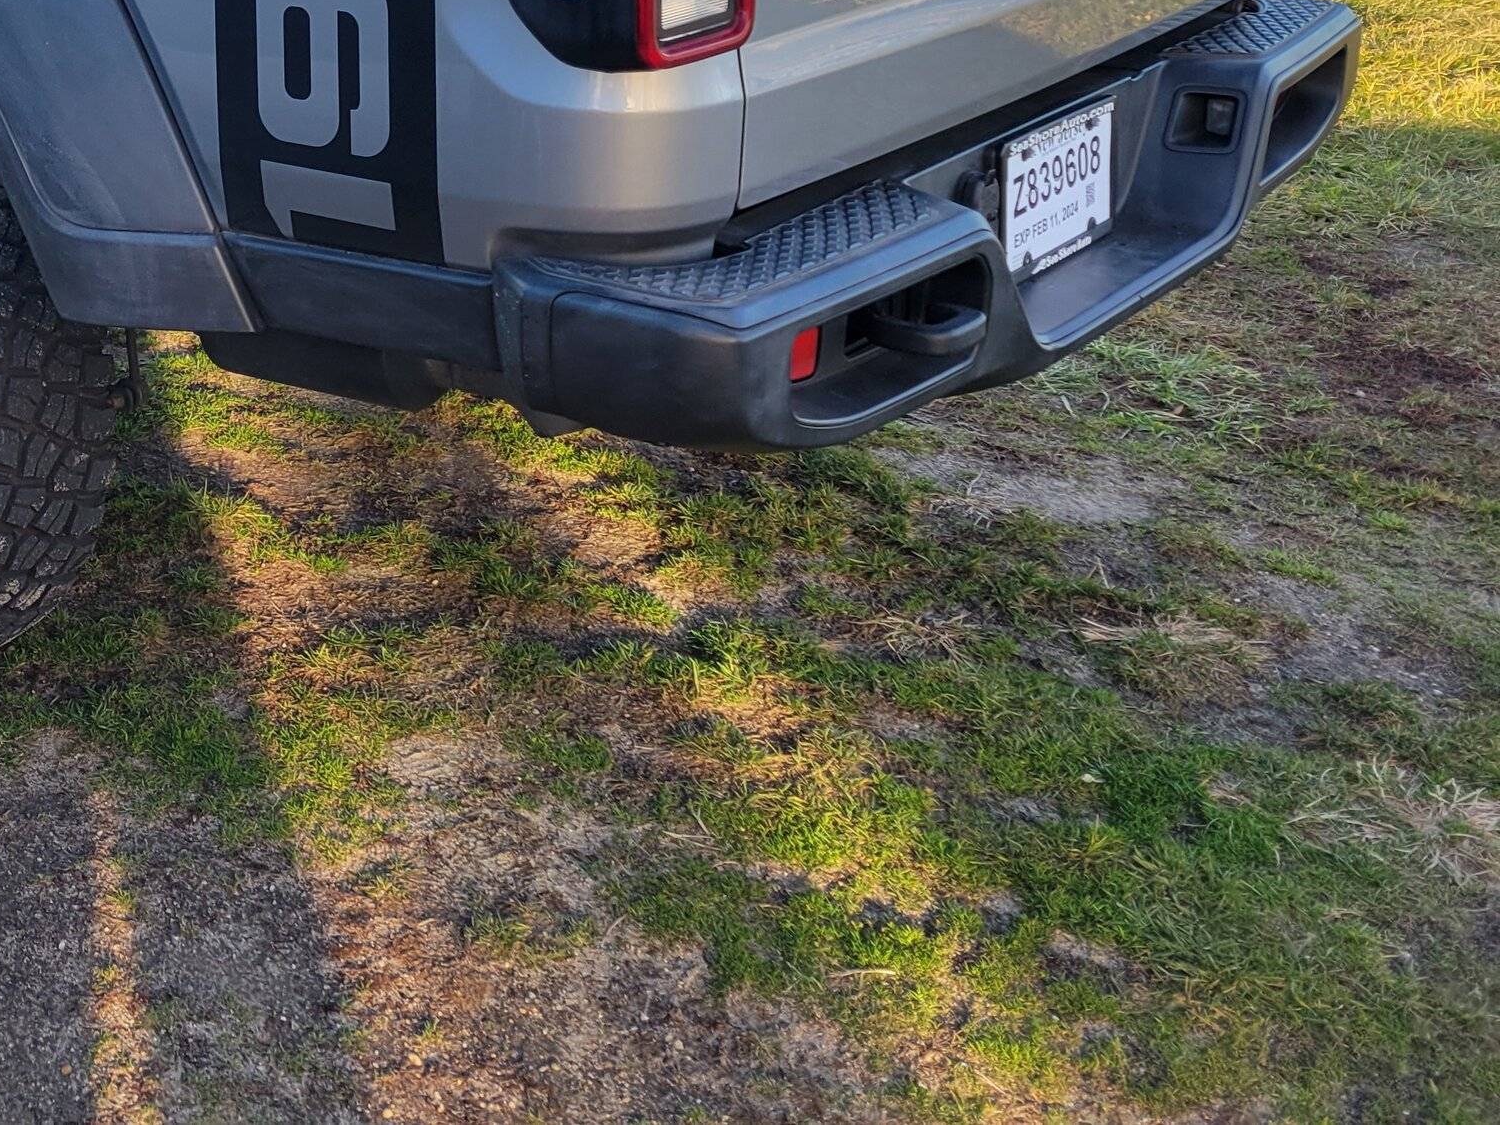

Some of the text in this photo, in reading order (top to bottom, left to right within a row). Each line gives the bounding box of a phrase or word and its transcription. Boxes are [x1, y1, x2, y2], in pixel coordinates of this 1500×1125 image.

[1013, 136, 1100, 219] Z839608
[1014, 228, 1030, 248] EXP
[1032, 219, 1048, 238] FEB
[1063, 200, 1079, 221] 2024
